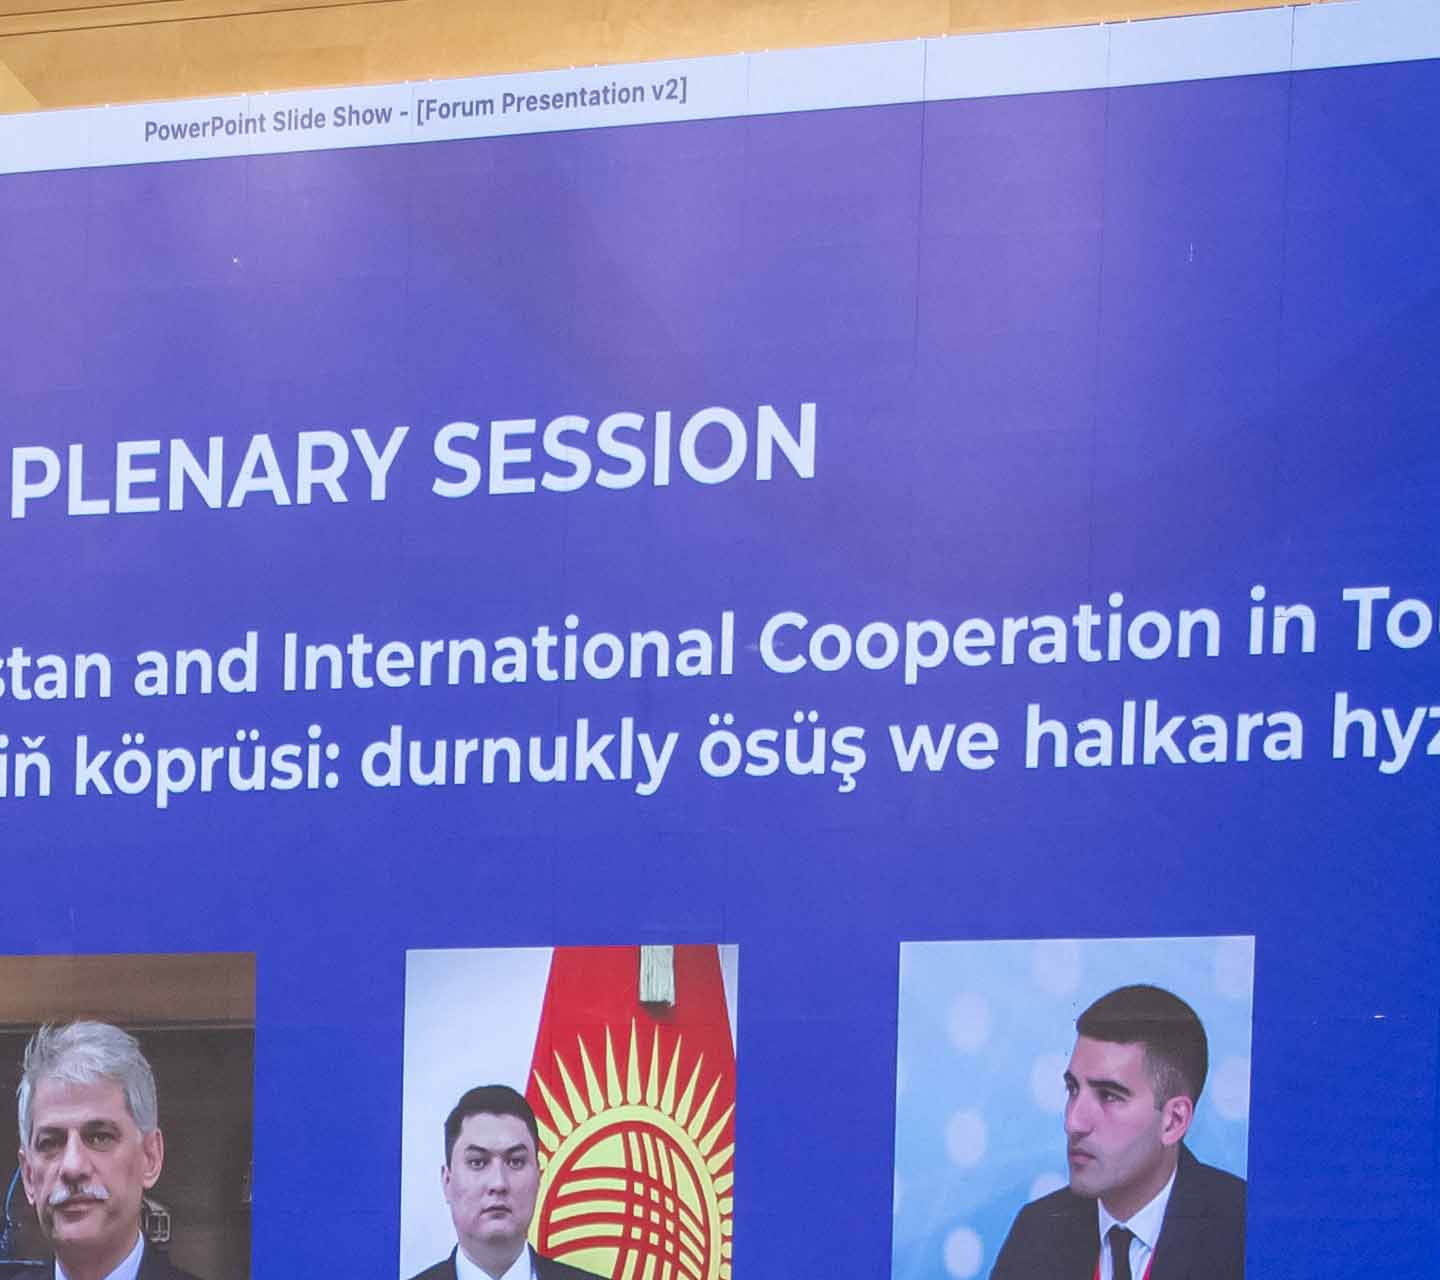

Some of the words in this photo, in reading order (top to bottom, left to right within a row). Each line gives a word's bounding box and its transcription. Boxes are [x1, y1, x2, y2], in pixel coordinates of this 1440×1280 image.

[144, 113, 266, 143] PowerPoint
[272, 107, 326, 132] Slide
[333, 104, 393, 128] Show
[416, 98, 495, 127] [Forum
[501, 81, 645, 114] Presentation
[651, 76, 688, 105] v2]
[11, 425, 410, 519] PLENARY
[431, 402, 817, 498] SESSION
[134, 631, 258, 697] and
[283, 610, 735, 691] International
[759, 591, 1220, 685] Cooperation
[1250, 585, 1316, 655] in
[75, 723, 340, 809] köprüsi:
[361, 716, 680, 796] durnukly
[699, 709, 867, 793] ösüş
[888, 721, 1000, 772] we
[1025, 699, 1303, 769] halkara
